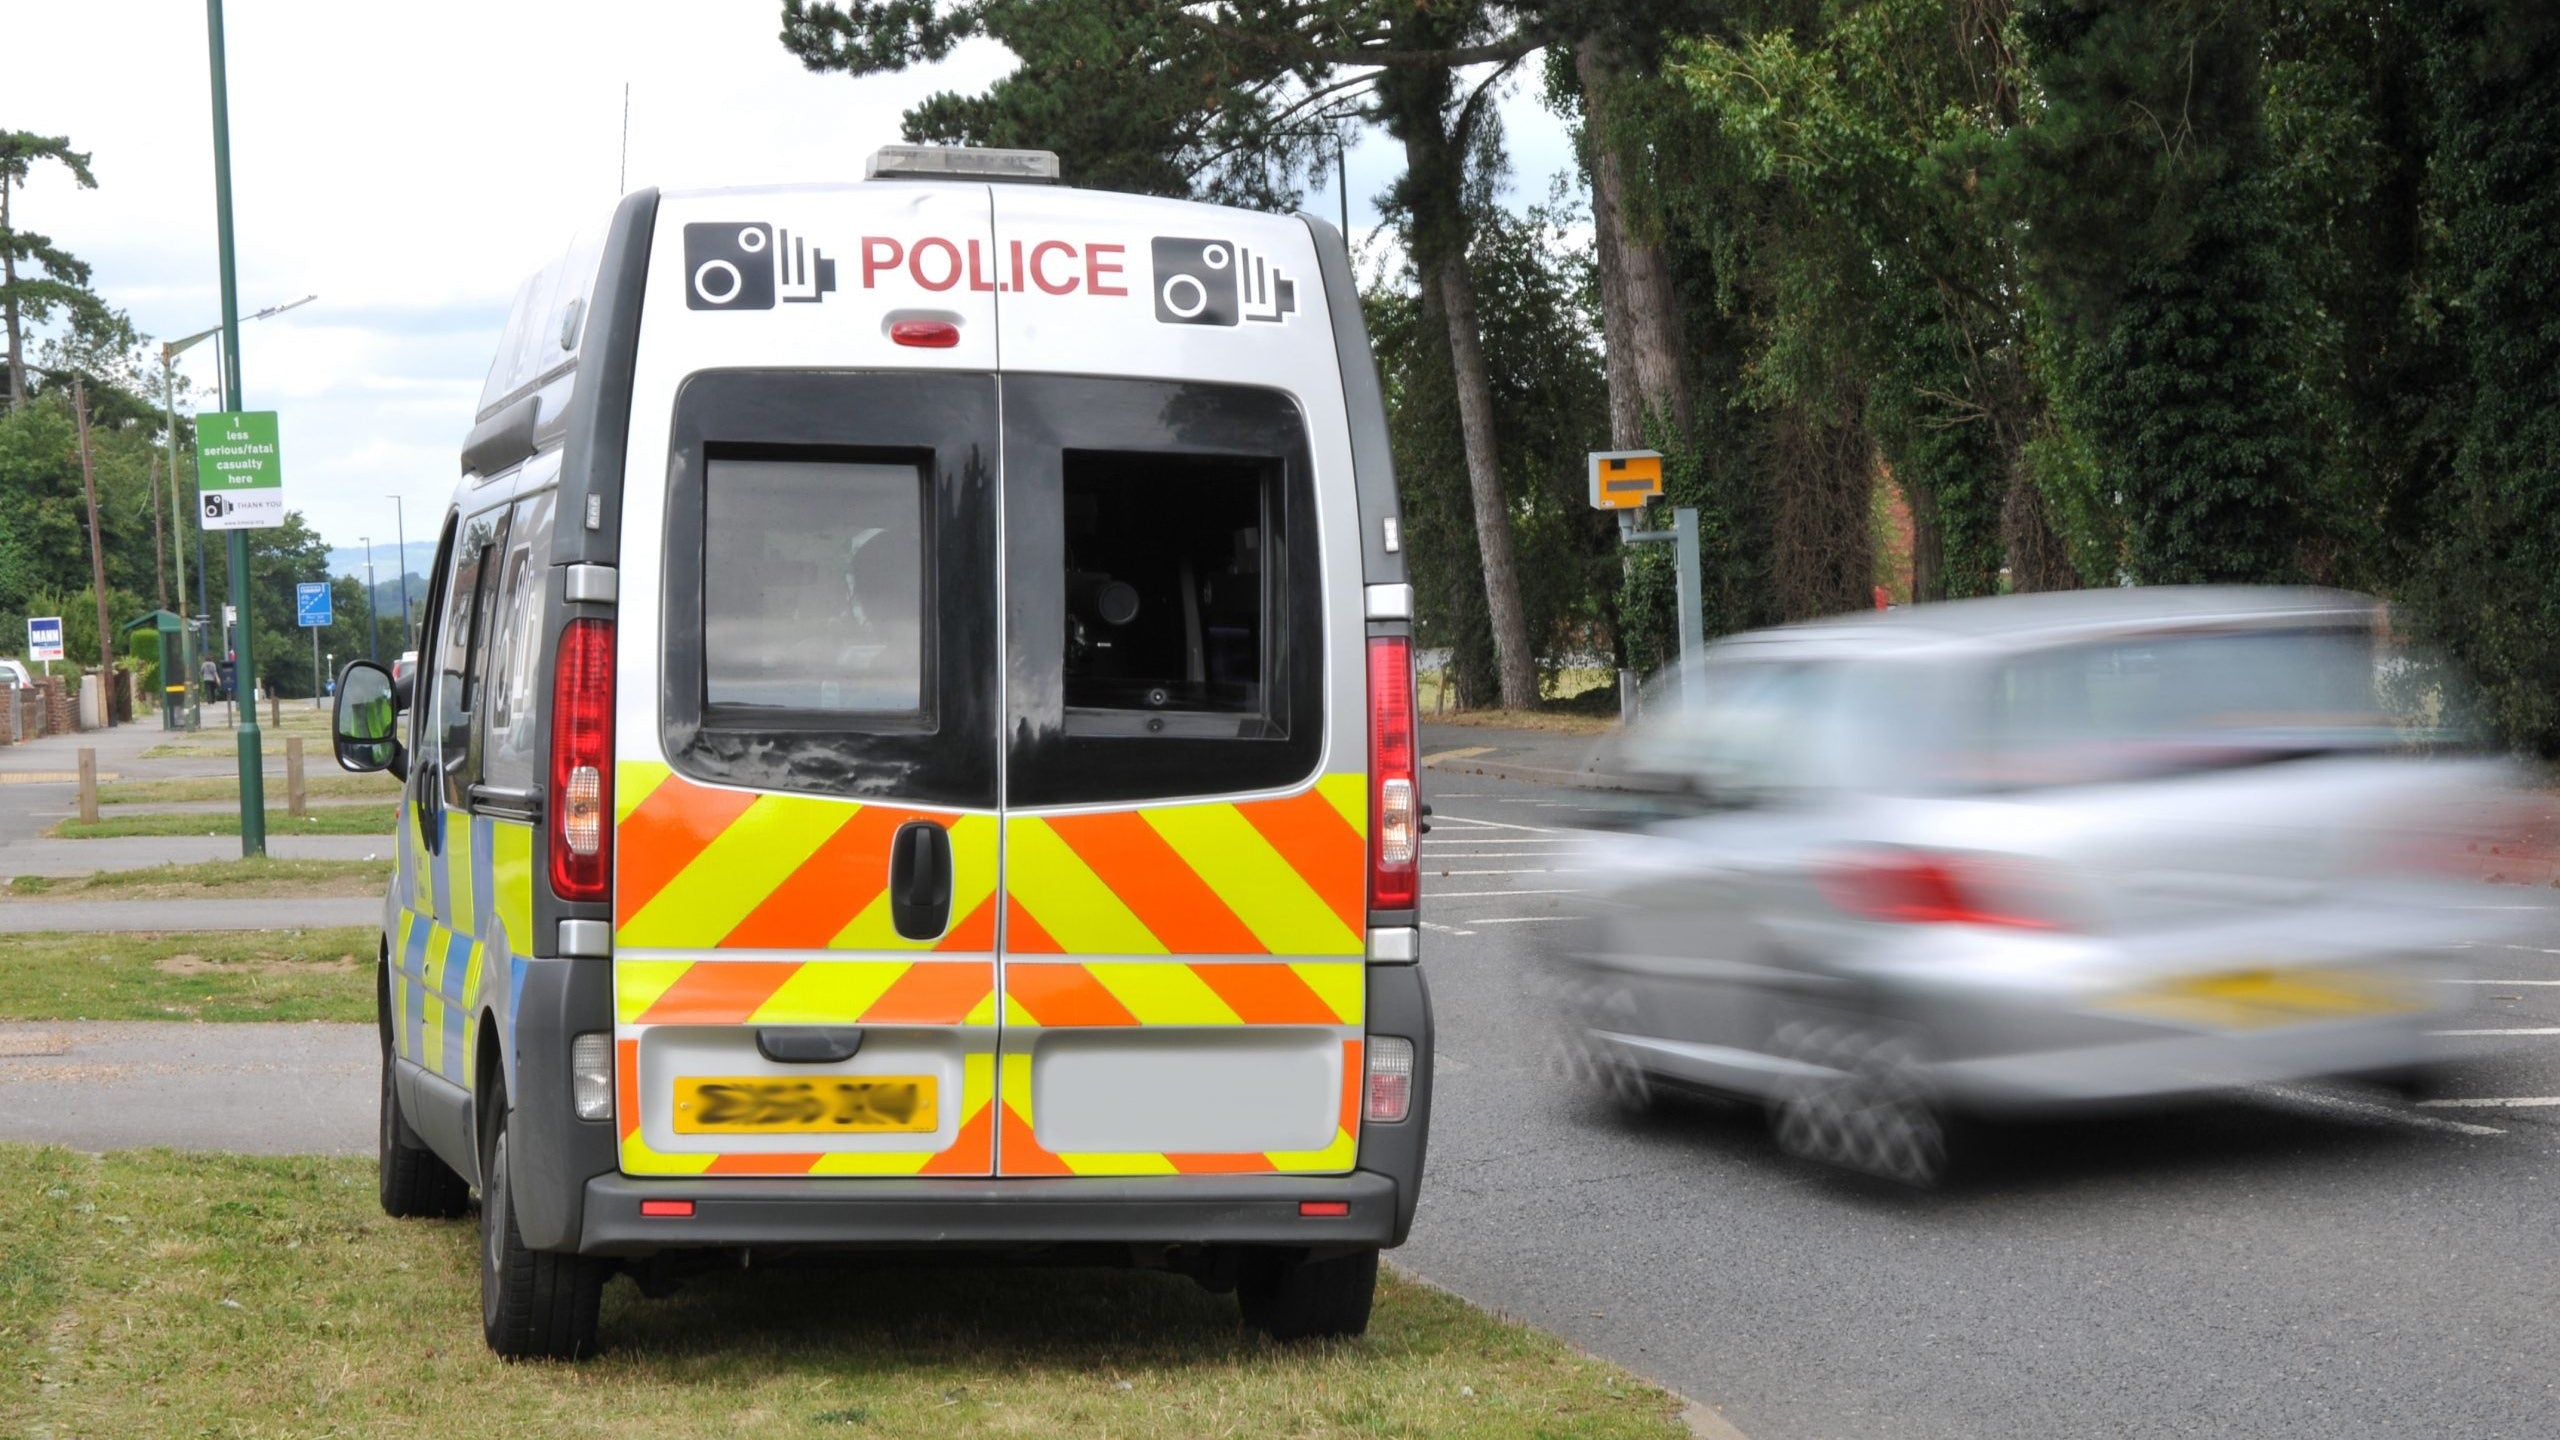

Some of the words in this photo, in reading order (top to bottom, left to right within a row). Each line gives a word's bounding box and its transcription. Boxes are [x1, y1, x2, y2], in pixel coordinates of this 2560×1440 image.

[861, 236, 1128, 297] POLICE
[233, 416, 240, 428] 1
[227, 430, 248, 440] less
[204, 444, 273, 456] serious/fatal
[216, 458, 263, 470] casualty
[228, 475, 253, 484] here
[266, 500, 282, 508] YOU
[32, 629, 59, 643] MANN
